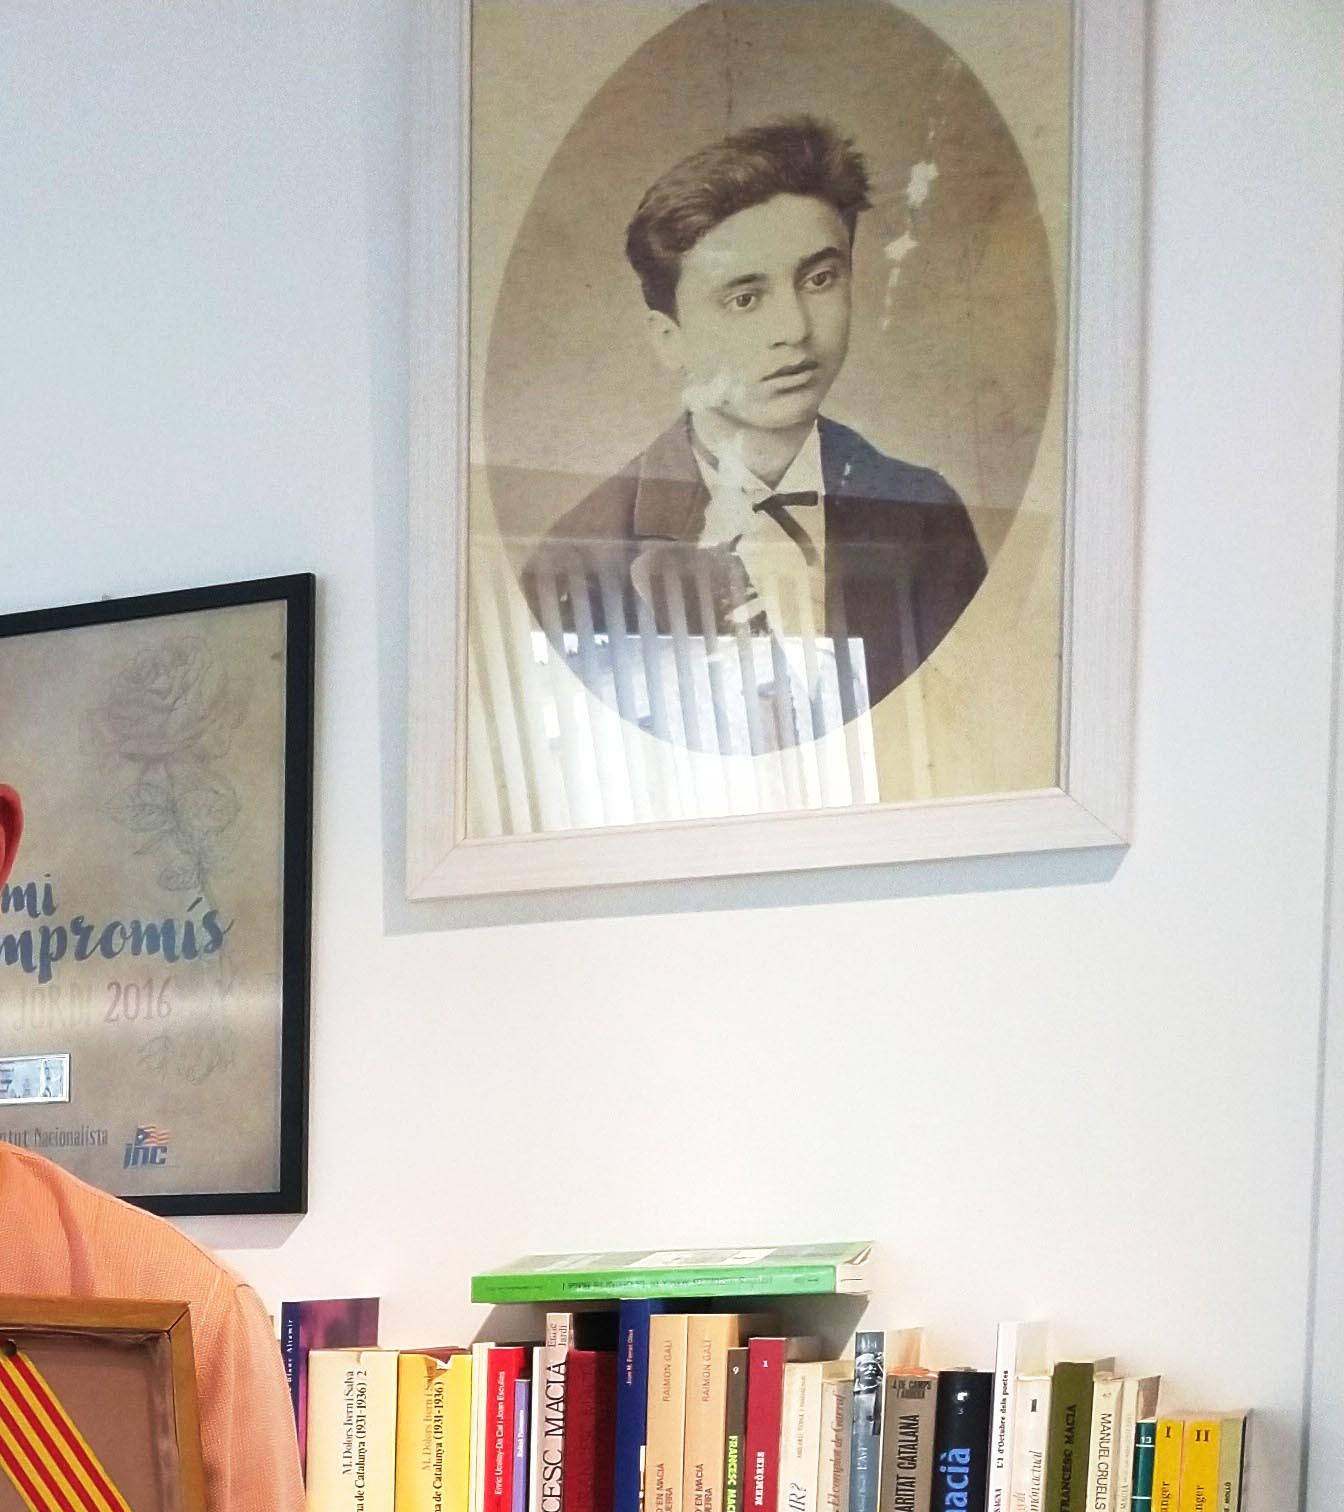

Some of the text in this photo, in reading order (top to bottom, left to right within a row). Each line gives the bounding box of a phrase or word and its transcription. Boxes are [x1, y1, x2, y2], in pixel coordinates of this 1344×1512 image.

[104, 977, 173, 1023] 2016
[33, 1125, 109, 1148] Nacionalista
[663, 1367, 672, 1402] RAIMON
[702, 1367, 711, 1402] RAIMON
[1001, 1370, 1009, 1396] poetes
[354, 1382, 368, 1439] (1931-1936)
[432, 1381, 445, 1440] (1931-1936)
[342, 1428, 354, 1459] Dolors
[831, 1436, 842, 1447] de
[897, 1415, 920, 1469] CATALANA
[996, 1417, 1008, 1454] d'Octubre
[1097, 1412, 1112, 1460] MANUEL
[1195, 1429, 1210, 1443] II
[354, 1441, 368, 1489] Catalunya
[431, 1442, 444, 1489] Catalunya
[727, 1436, 738, 1486] FRANCESC
[354, 1491, 364, 1502] de
[432, 1491, 442, 1502] de
[1095, 1463, 1109, 1510] CRUELLS
